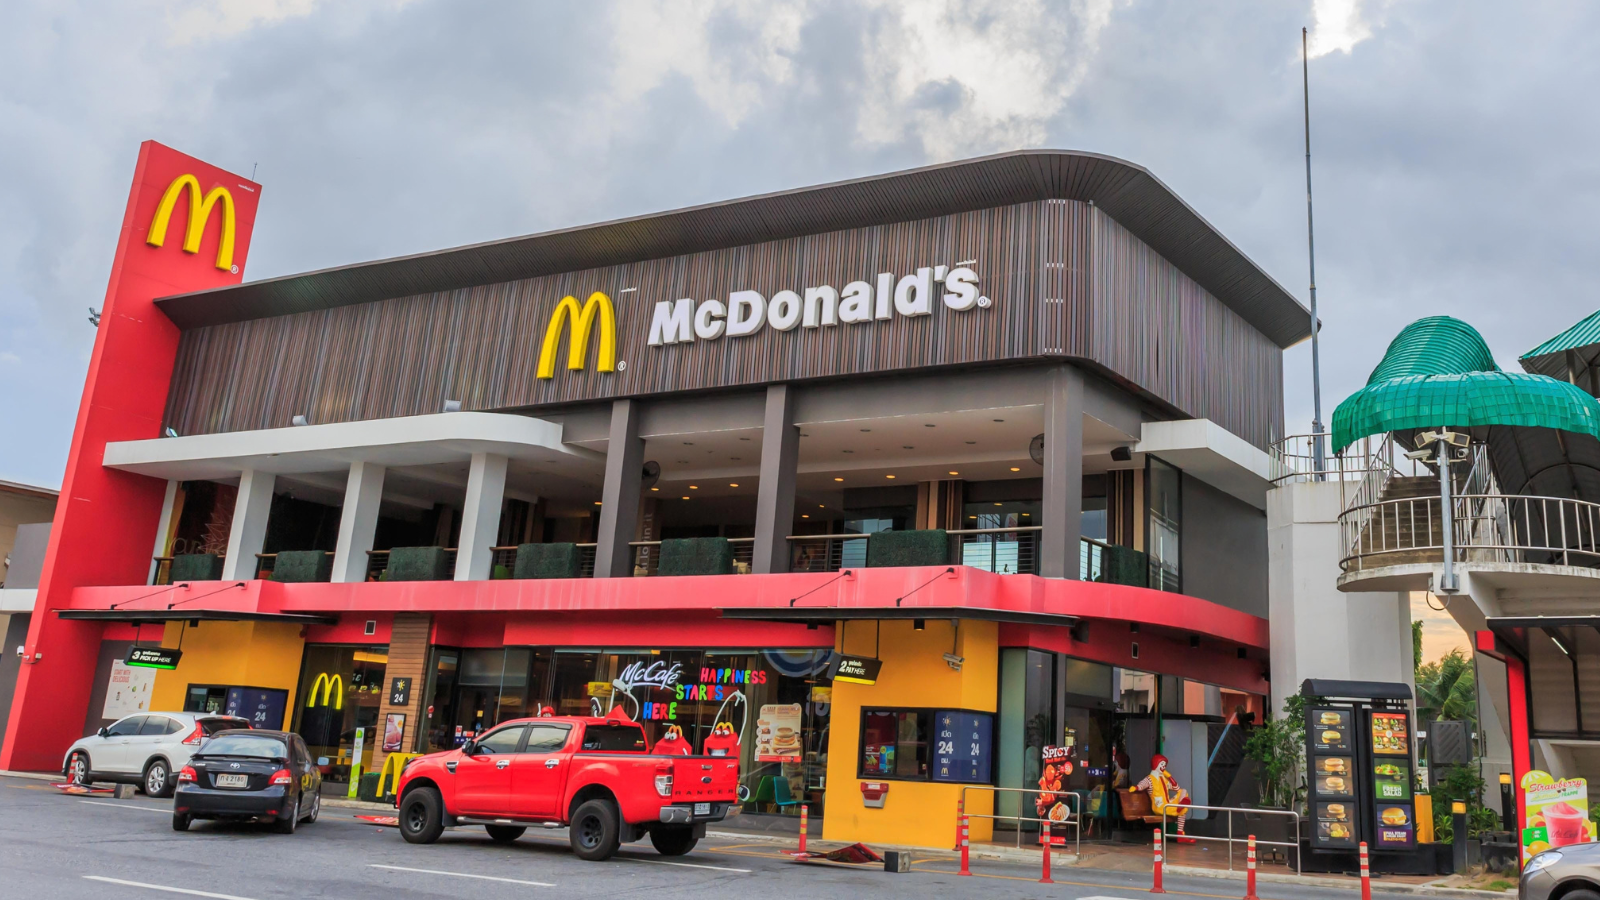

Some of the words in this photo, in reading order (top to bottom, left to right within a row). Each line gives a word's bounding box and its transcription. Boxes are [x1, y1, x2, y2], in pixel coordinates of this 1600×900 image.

[647, 266, 979, 346] McDonald's
[132, 650, 141, 660] 3
[838, 660, 848, 673] 2
[845, 666, 856, 674] PAY
[854, 667, 866, 675] HERE
[619, 660, 684, 691] McCafé
[393, 693, 403, 703] 24
[675, 684, 724, 701] STARTS
[254, 711, 266, 721] 24
[642, 701, 678, 720] HERE
[938, 741, 954, 754] 24
[970, 742, 980, 756] 24
[1529, 779, 1584, 793] Strawberry
